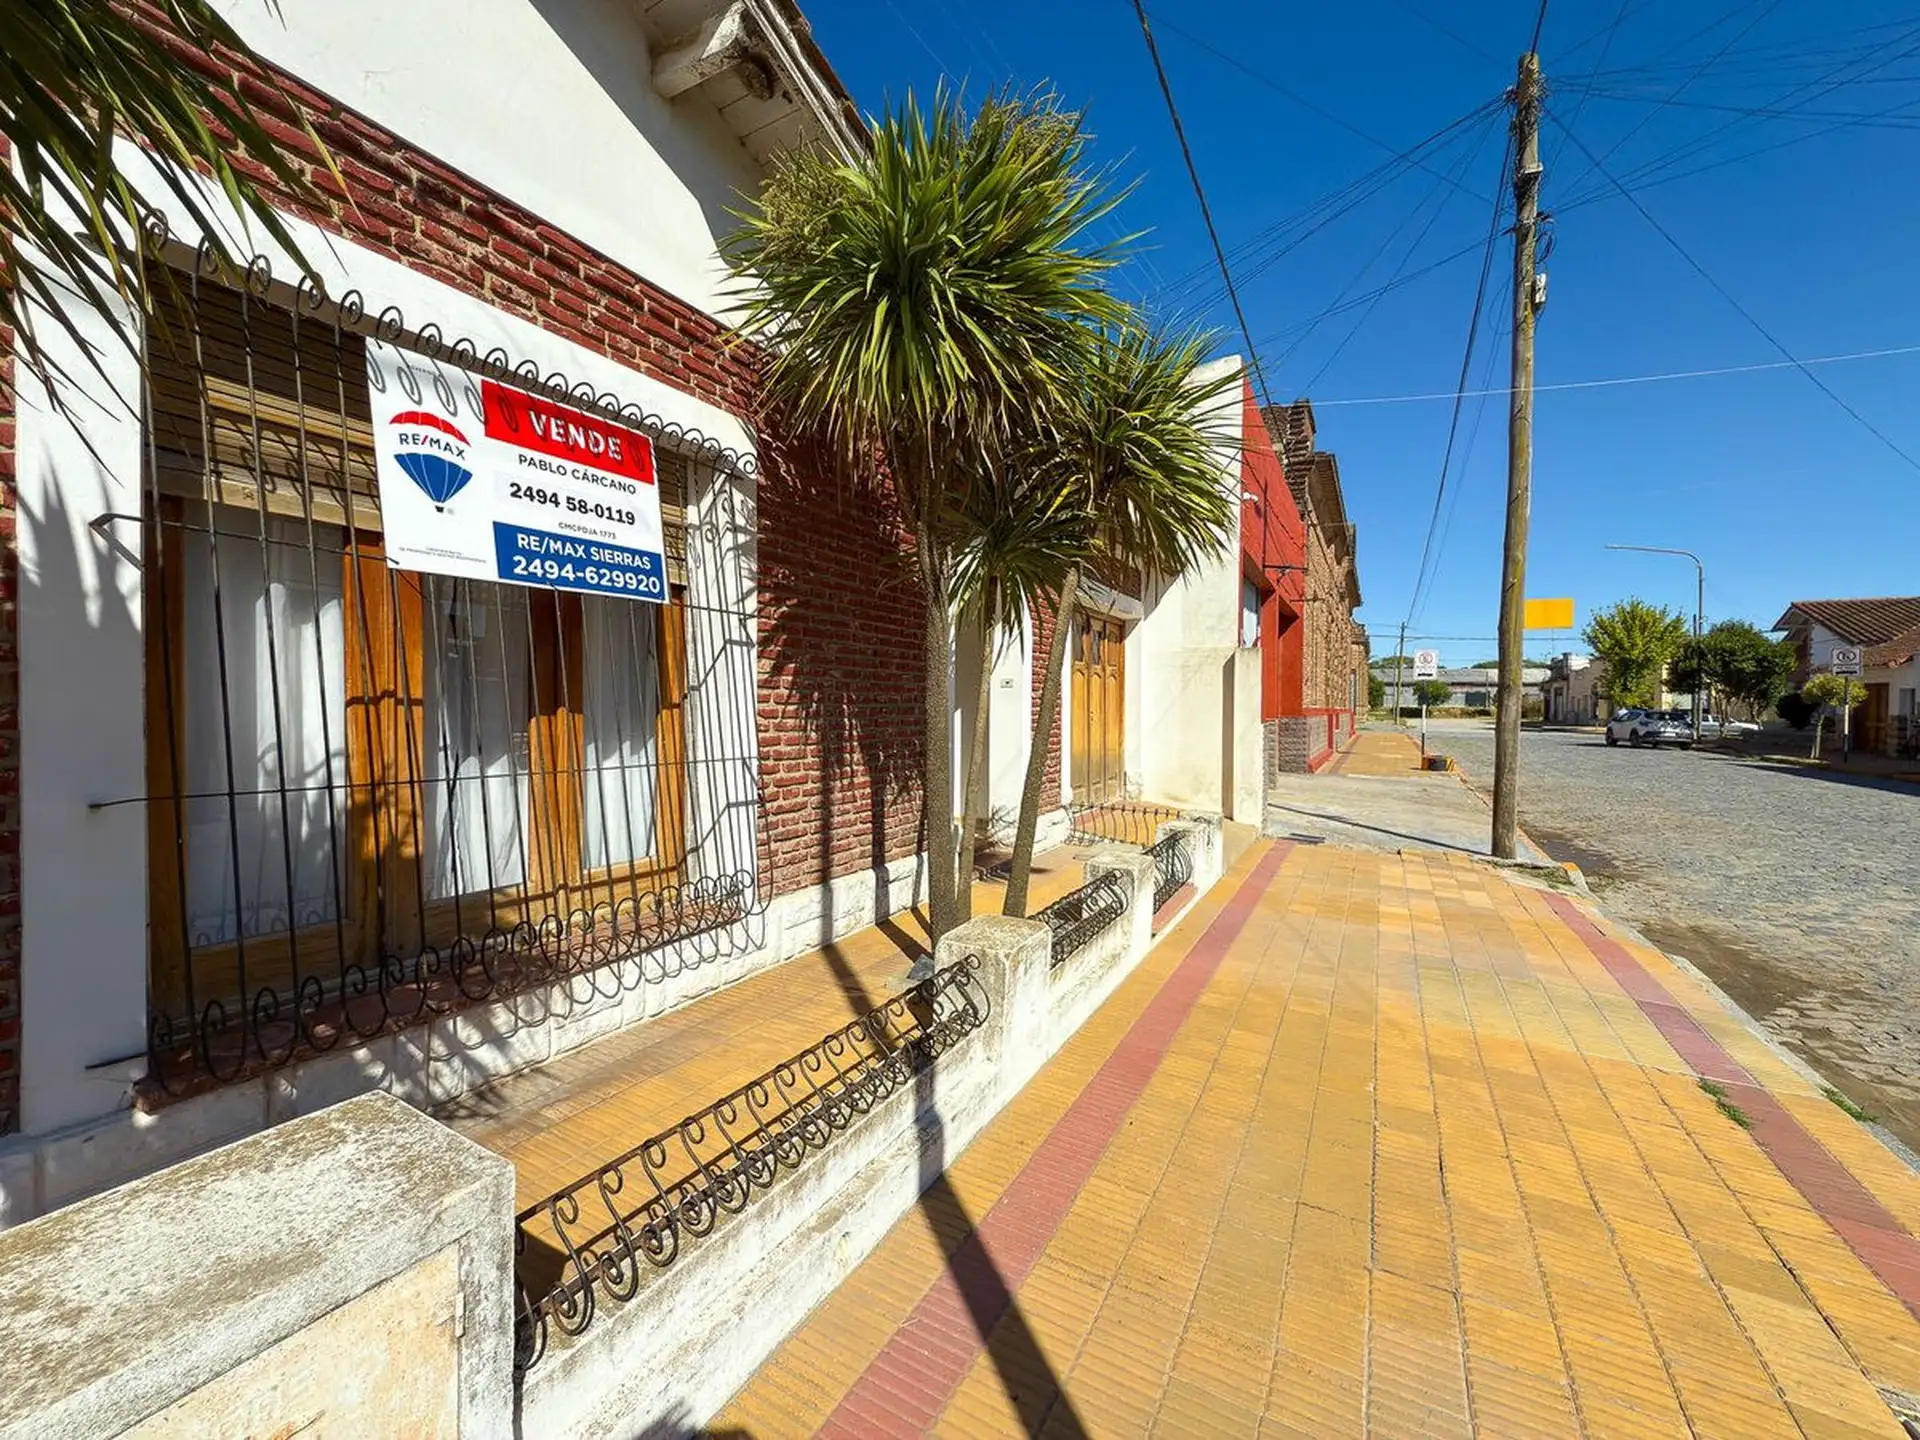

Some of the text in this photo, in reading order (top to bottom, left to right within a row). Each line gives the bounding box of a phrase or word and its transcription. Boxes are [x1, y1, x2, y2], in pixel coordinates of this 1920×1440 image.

[398, 432, 467, 461] RE/MAX
[528, 409, 622, 461] VENDE
[518, 453, 637, 495] PABLO CÁRCANO
[510, 482, 636, 526] 2494 58-0119
[517, 533, 651, 570] RE/MAX SIERRAS
[512, 555, 661, 594] 2494-629920
